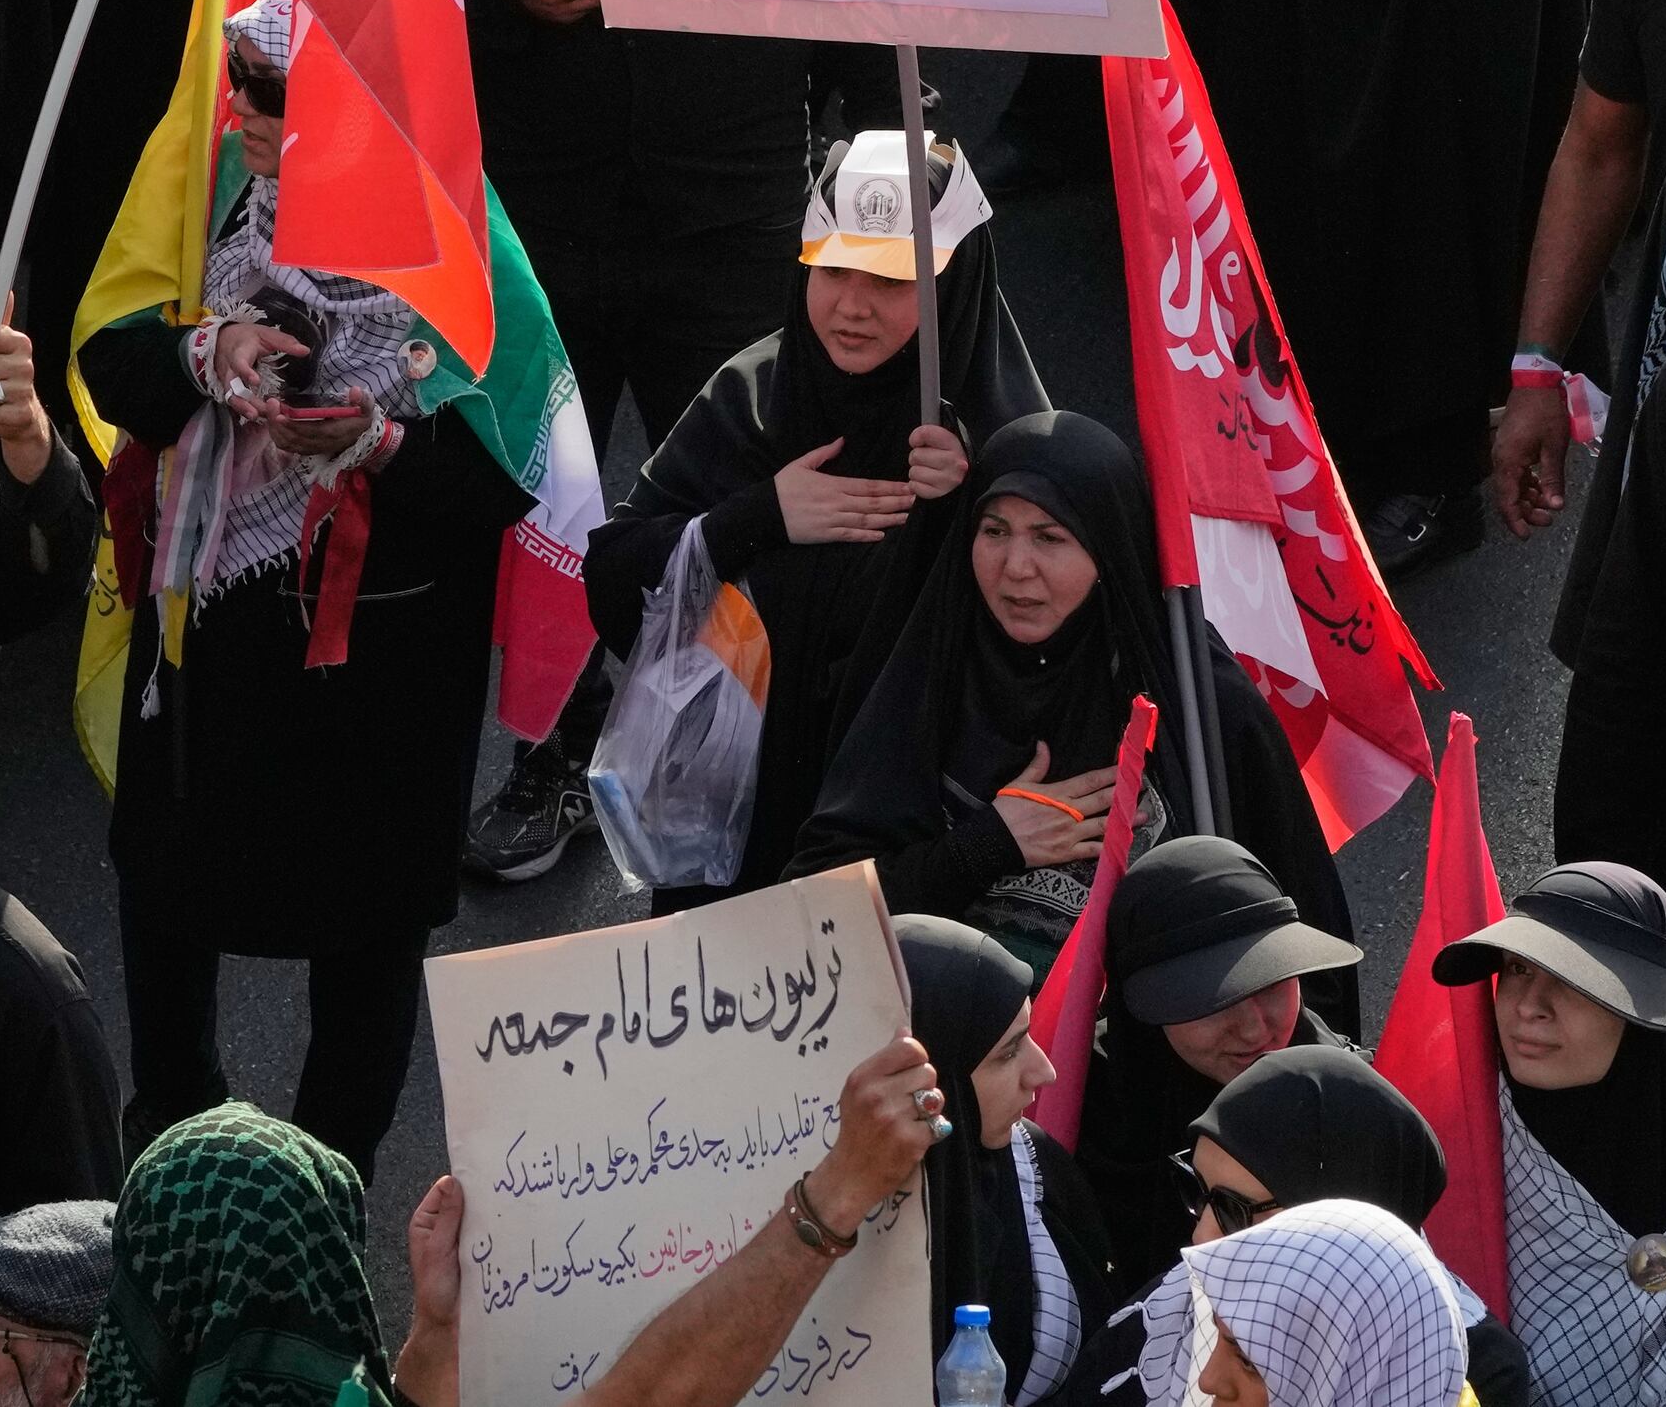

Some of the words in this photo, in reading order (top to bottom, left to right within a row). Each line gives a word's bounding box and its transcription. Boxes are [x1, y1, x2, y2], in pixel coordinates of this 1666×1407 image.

[740, 919, 842, 1058] تریبون
[475, 1010, 590, 1075] جمعه
[736, 1105, 768, 1170] باید
[771, 1092, 820, 1156] تقلید
[534, 1218, 594, 1297] سکوت
[598, 1224, 636, 1286] بگیرد
